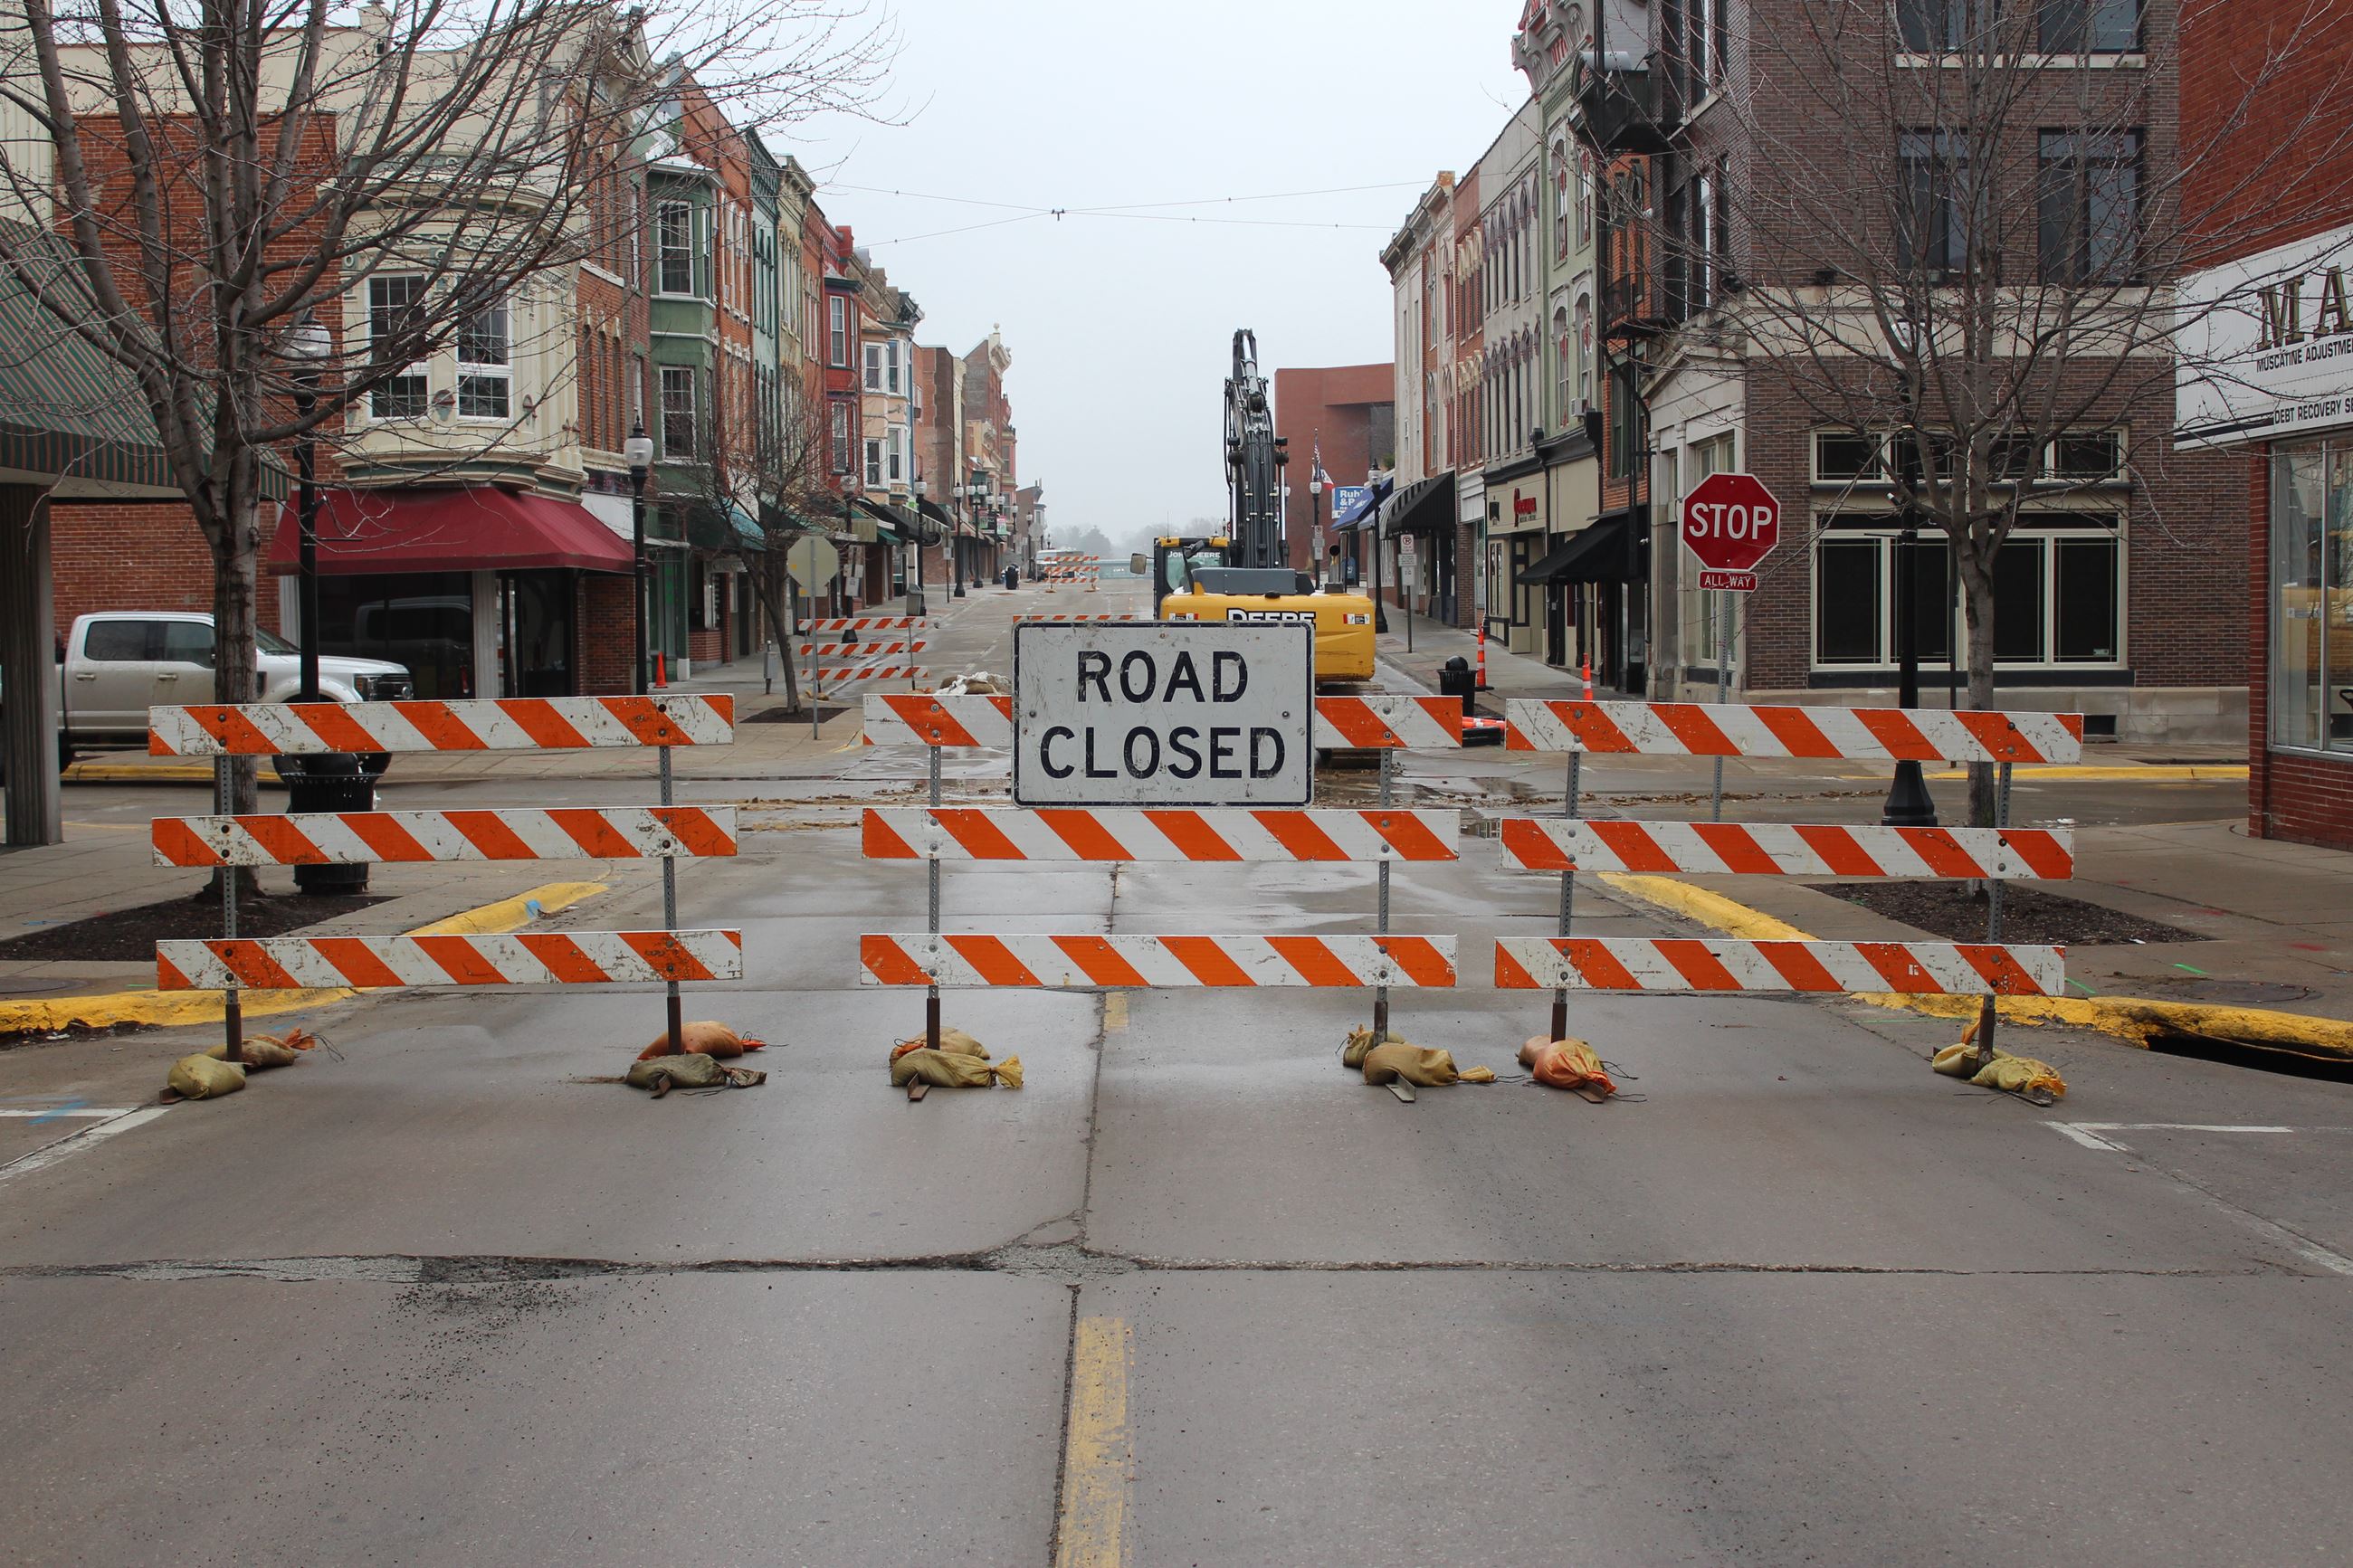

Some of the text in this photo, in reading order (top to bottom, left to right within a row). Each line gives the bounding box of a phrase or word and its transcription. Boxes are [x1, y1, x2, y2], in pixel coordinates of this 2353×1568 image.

[2256, 348, 2302, 373] MUSCATINE
[2274, 407, 2294, 424] DEBT
[2298, 399, 2341, 421] RECOVERY
[1339, 489, 1363, 498] Ruh
[1689, 502, 1773, 540] STOP
[1704, 575, 1751, 587] ALL WAY
[1077, 650, 1248, 704] ROAD
[1040, 726, 1285, 780] CLOSED
